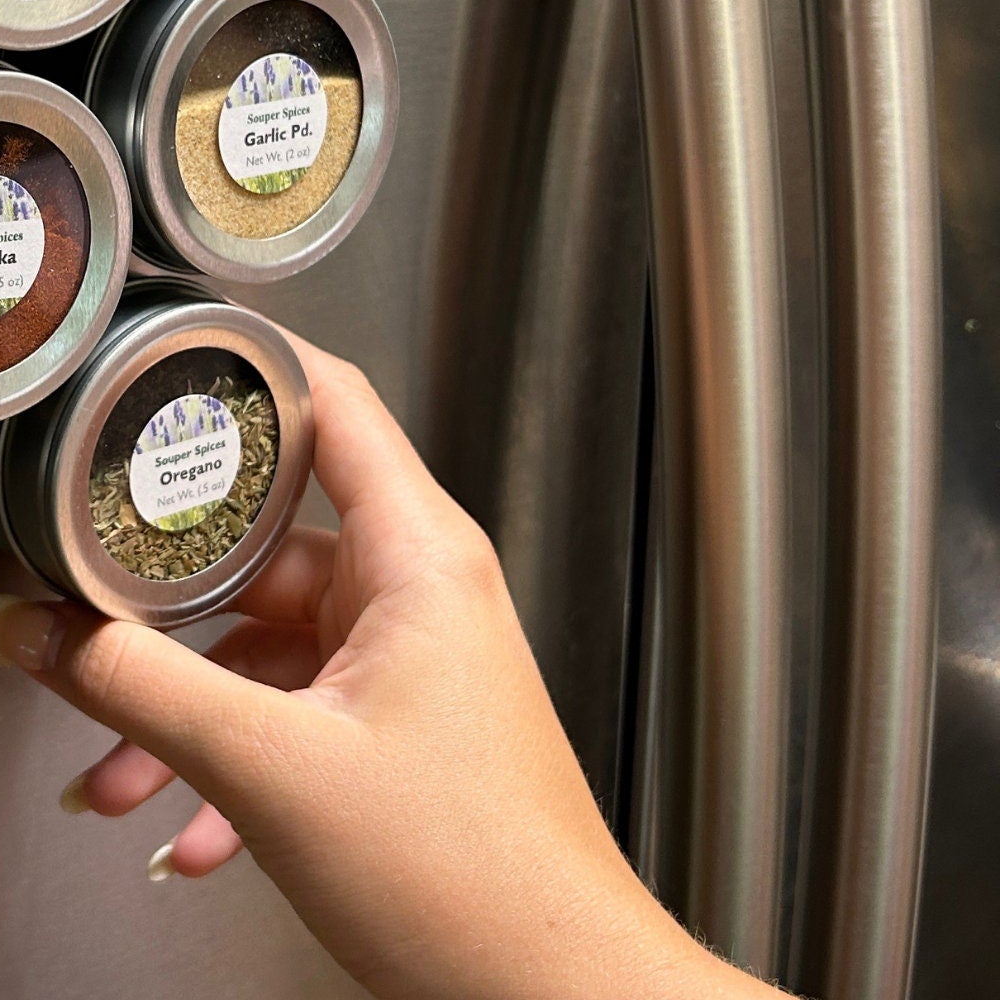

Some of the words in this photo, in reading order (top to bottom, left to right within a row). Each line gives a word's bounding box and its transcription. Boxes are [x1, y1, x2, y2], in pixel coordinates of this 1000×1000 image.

[247, 111, 281, 124] Souper
[282, 106, 310, 119] Spices
[245, 128, 286, 146] Garlic
[291, 122, 313, 139] Pd.
[246, 156, 264, 167] Net
[286, 149, 294, 162] (2
[297, 147, 310, 157] oz)
[8, 275, 24, 288] oz)
[155, 450, 192, 467] Souper
[195, 439, 226, 456] Spices
[160, 459, 222, 485] Oregano
